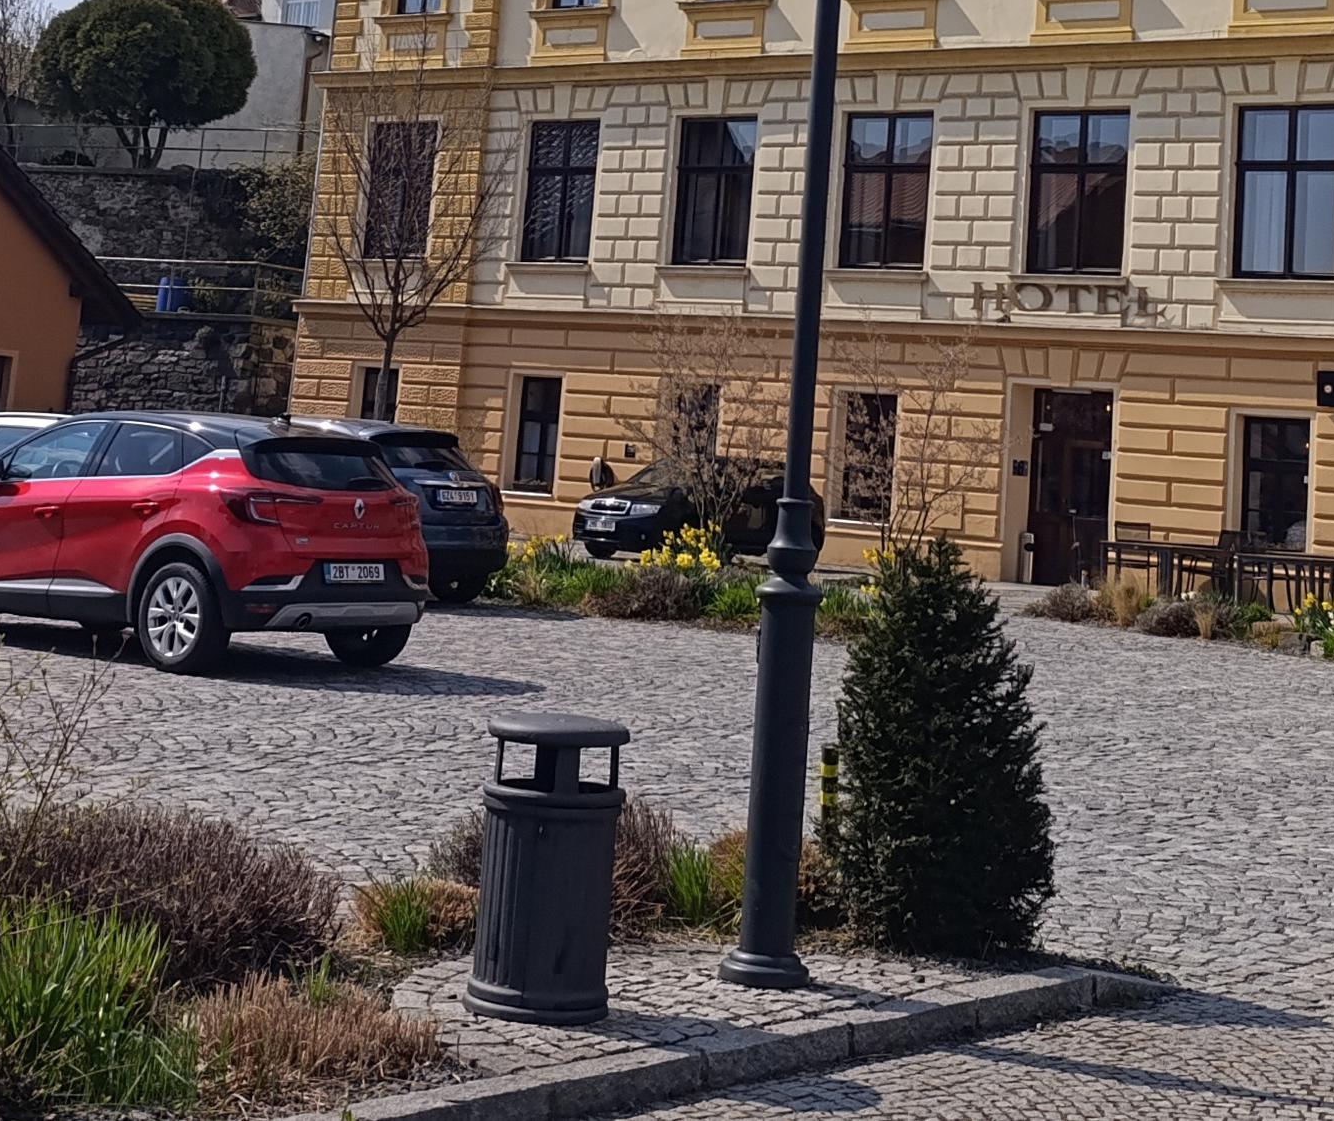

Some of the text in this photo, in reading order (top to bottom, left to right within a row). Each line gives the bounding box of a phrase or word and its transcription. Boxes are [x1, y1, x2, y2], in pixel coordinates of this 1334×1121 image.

[971, 281, 1169, 318] HOTEL
[332, 565, 380, 579] 2BT 2069
